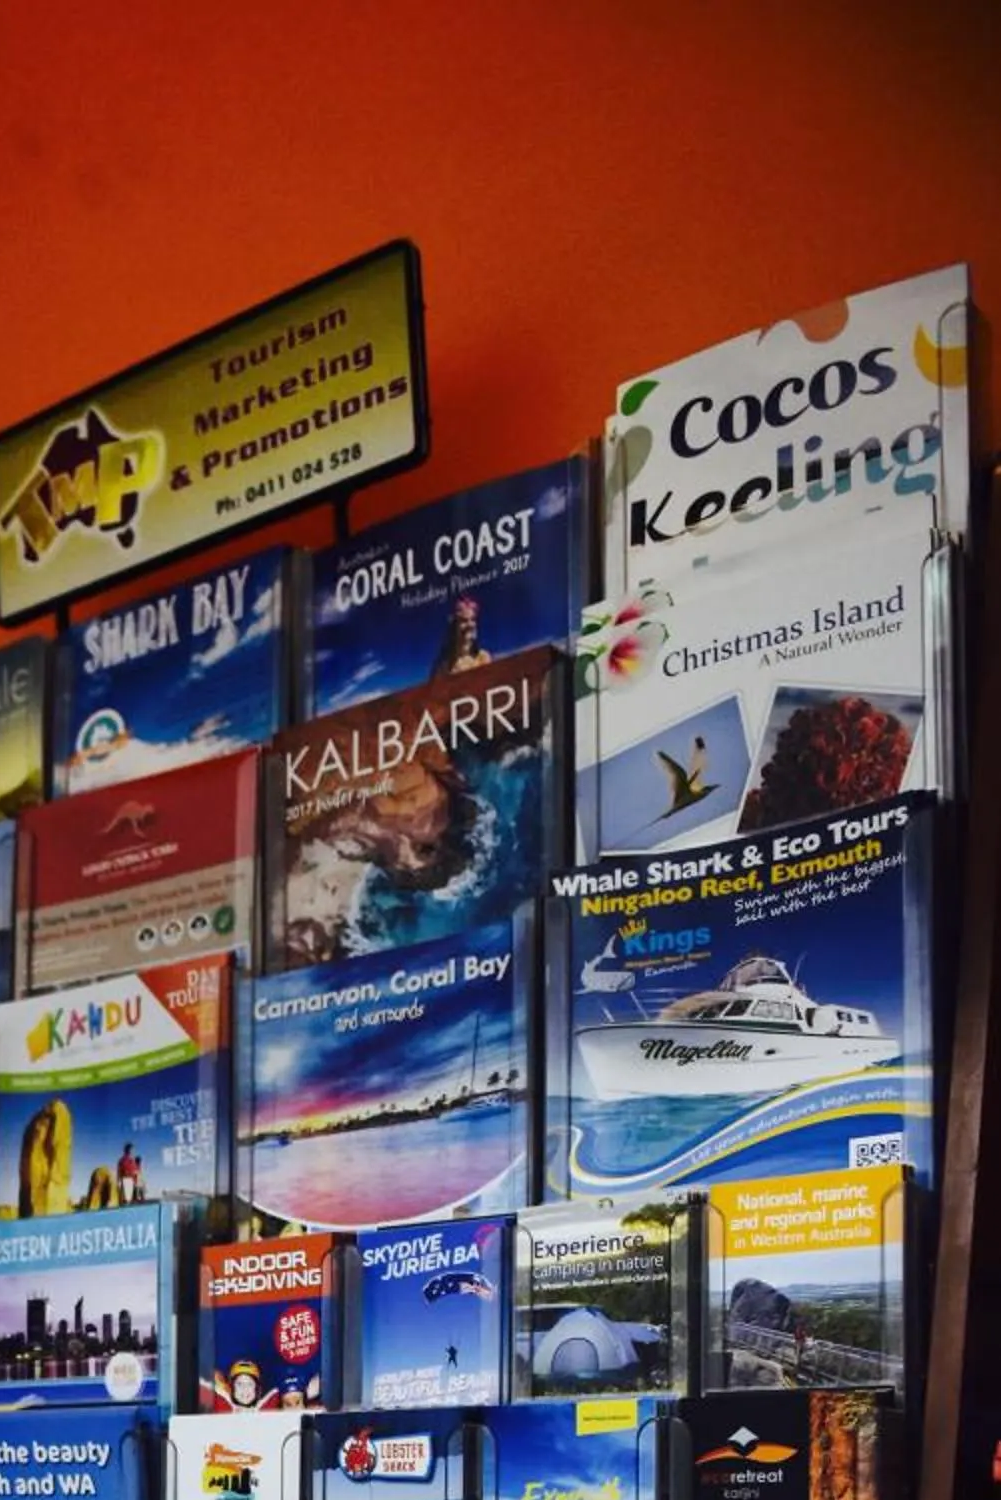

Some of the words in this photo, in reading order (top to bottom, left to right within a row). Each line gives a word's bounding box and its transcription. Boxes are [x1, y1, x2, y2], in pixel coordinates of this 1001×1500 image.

[209, 306, 347, 383] Tourism
[193, 342, 374, 438] Marketing
[670, 347, 897, 459] Cocos
[170, 463, 193, 491] &
[202, 374, 408, 478] Promotions
[215, 493, 242, 516] Ph:
[247, 473, 286, 502] 0411
[292, 458, 324, 486] 024
[329, 442, 363, 472] 528
[630, 411, 942, 547] Keeling
[335, 549, 423, 613] CORAL
[434, 508, 535, 575] COAST
[502, 554, 530, 575] 2017
[83, 595, 179, 673] SHARK
[192, 565, 250, 636] BAY
[663, 621, 803, 677] Christmas
[813, 585, 905, 635] Island
[759, 653, 770, 669] A
[776, 636, 833, 663] Natural
[839, 620, 903, 648] Wonder
[286, 678, 530, 798] KALBARRI
[553, 864, 638, 898] Whale
[647, 851, 734, 885] Shark
[741, 845, 764, 869] &
[773, 832, 821, 861] Eco
[828, 806, 909, 844] Tours
[581, 885, 693, 917] Ningaloo
[702, 870, 764, 897] Reef,
[771, 838, 882, 885] Exmouth
[735, 894, 779, 913] Swim
[785, 881, 821, 899] with
[824, 871, 849, 887] the
[735, 909, 766, 927] sail
[771, 900, 807, 917] with
[811, 890, 836, 906] the
[842, 878, 872, 896] best
[623, 927, 712, 957] Kings
[254, 982, 382, 1021] Carnarvon,
[390, 958, 455, 995] Coral
[464, 953, 512, 982] Bay
[639, 1037, 753, 1065] Magellan
[812, 1184, 869, 1205] marine
[731, 1211, 758, 1231] and
[764, 1206, 828, 1230] regional
[832, 1202, 875, 1224] parks
[58, 1223, 158, 1257] AUSTRALIA
[362, 1233, 443, 1268] SKYDIVE
[534, 1234, 645, 1261] Experience
[734, 1235, 746, 1249] in
[750, 1231, 805, 1248] Western
[810, 1224, 871, 1243] Australia
[224, 1250, 307, 1275] INDOOR
[382, 1252, 450, 1281] JURIEN
[453, 1243, 484, 1267] BA
[533, 1262, 595, 1280] camping
[599, 1258, 612, 1272] in
[616, 1254, 664, 1272] nature
[208, 1271, 323, 1297] SKYDIVING
[280, 1311, 311, 1330] SAFE
[291, 1323, 315, 1340] FUN
[32, 1441, 109, 1468] beauty
[380, 1443, 424, 1459] LOBSTER
[15, 1472, 54, 1495] and
[59, 1474, 95, 1495] WA
